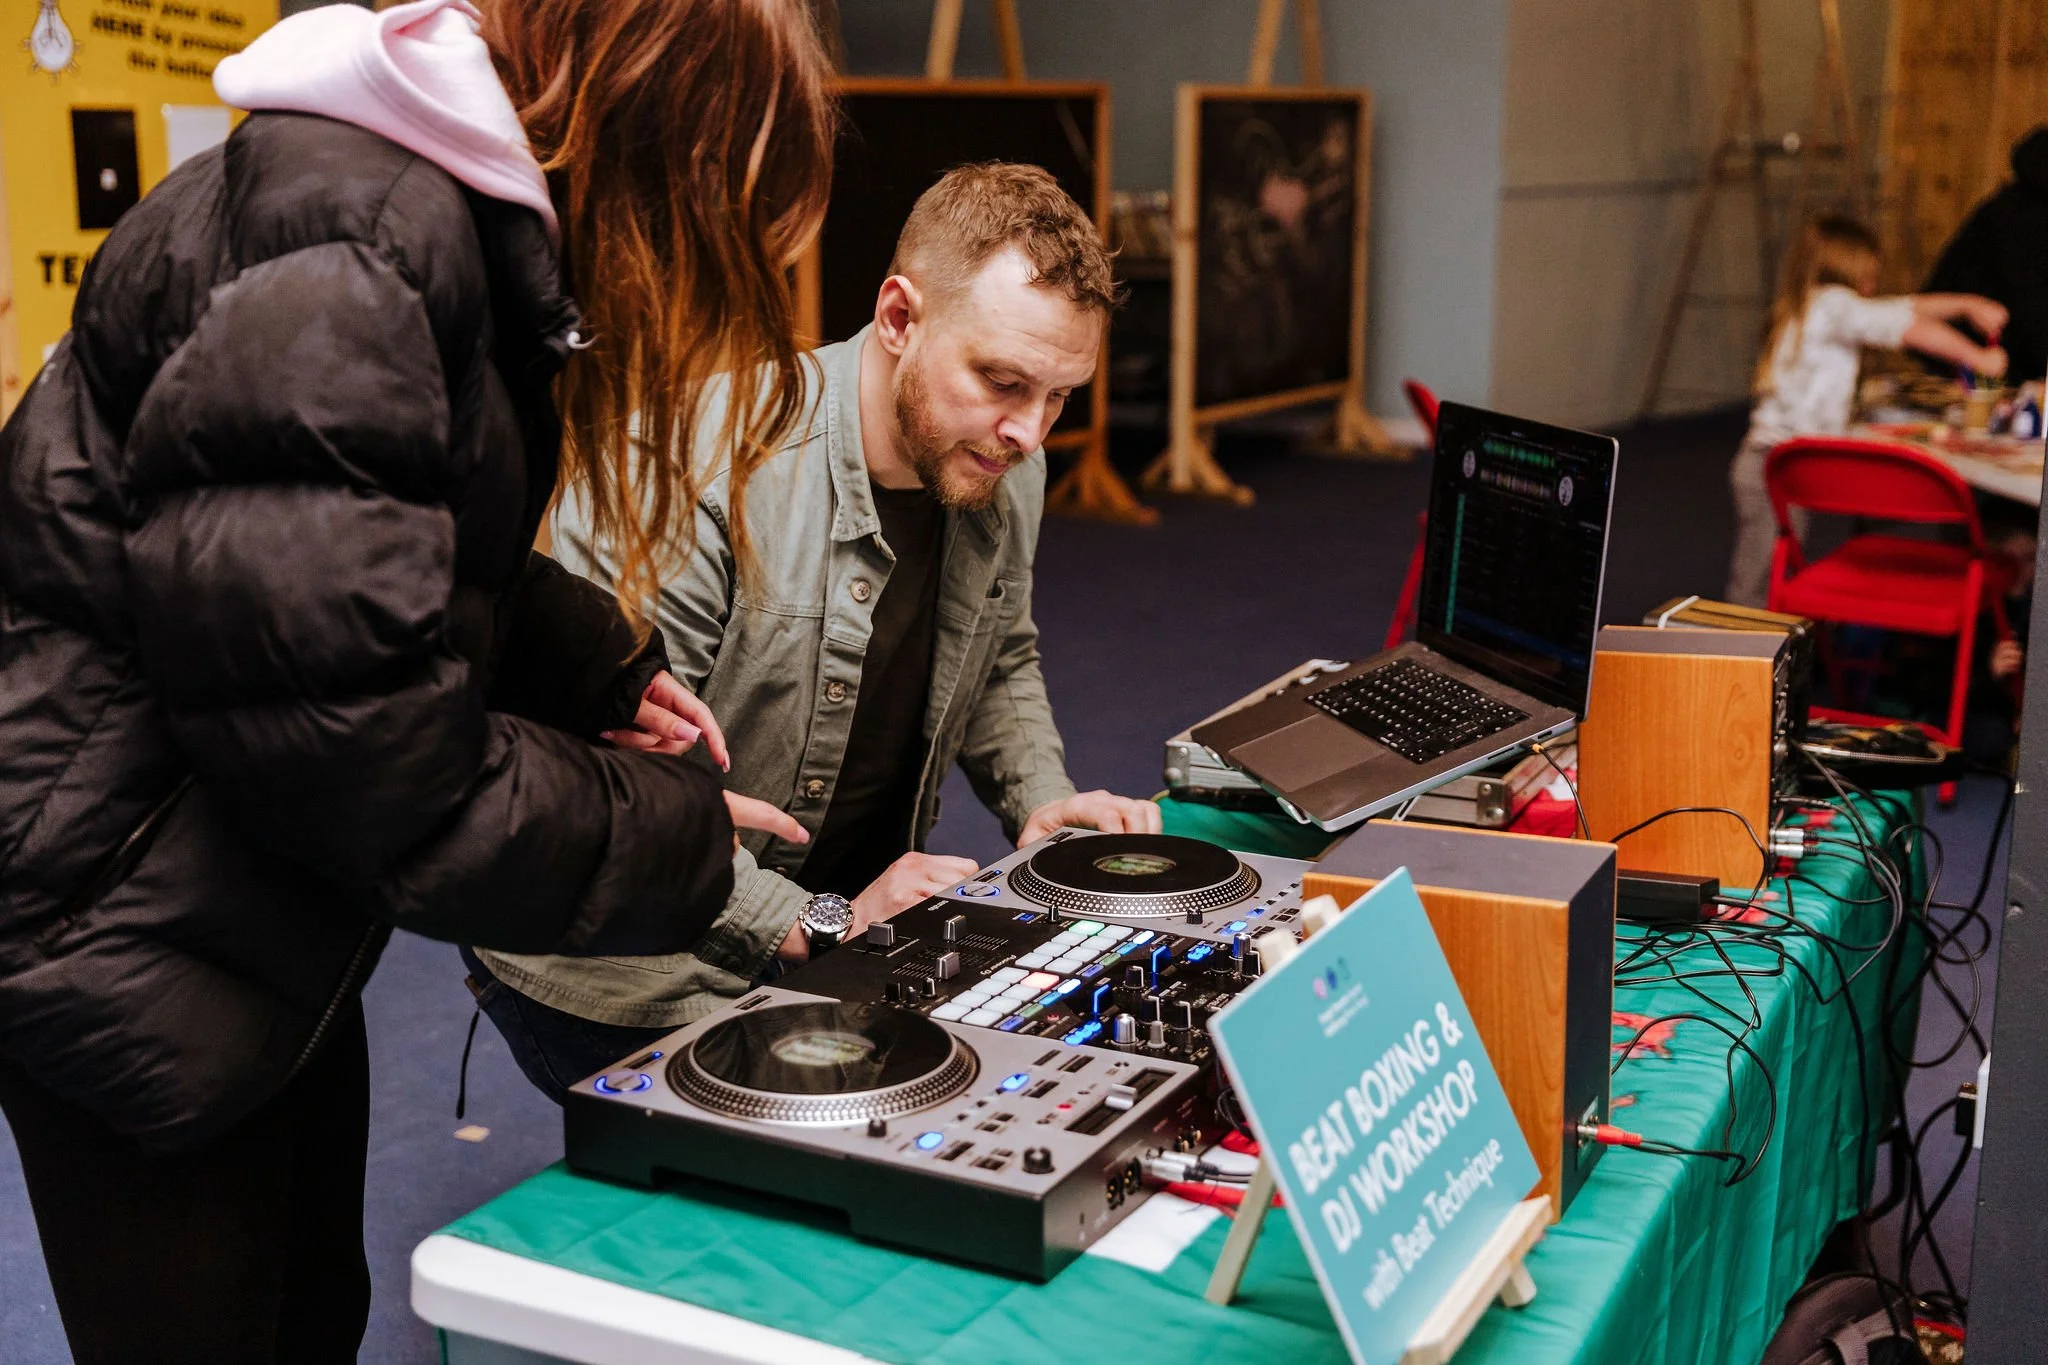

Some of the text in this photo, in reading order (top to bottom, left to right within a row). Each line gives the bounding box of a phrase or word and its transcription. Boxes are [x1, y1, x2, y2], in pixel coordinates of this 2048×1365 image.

[1288, 1100, 1356, 1196] BEAT
[1345, 1019, 1441, 1136] BOXING
[1435, 1001, 1464, 1048] &
[1321, 1058, 1479, 1255] DJ WORKSHOP
[1362, 1137, 1504, 1311] with Beat Technique
